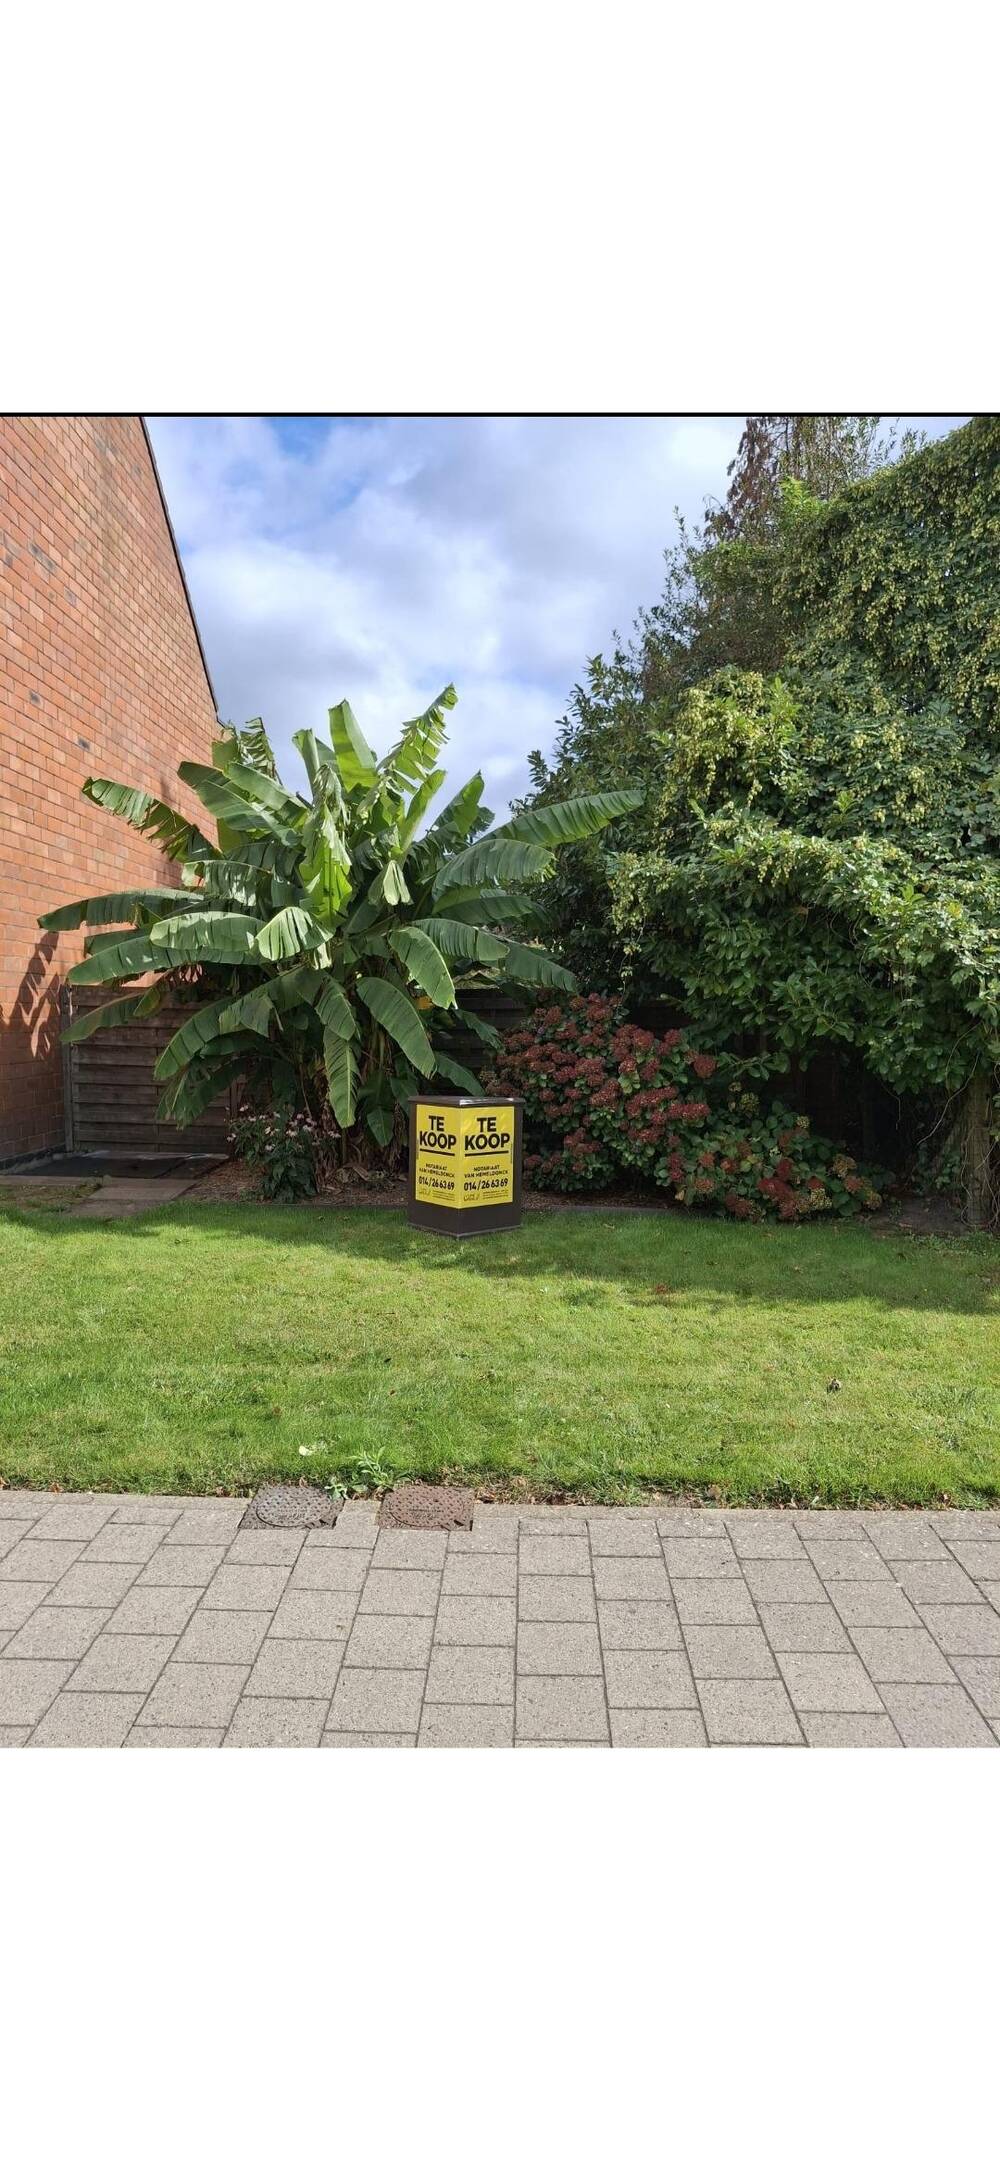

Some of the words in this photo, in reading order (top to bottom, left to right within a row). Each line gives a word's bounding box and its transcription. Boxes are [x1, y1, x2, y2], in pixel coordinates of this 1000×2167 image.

[428, 1115, 445, 1131] TE
[476, 1117, 497, 1133] TE
[419, 1131, 456, 1150] KOOP
[464, 1133, 510, 1150] KOOP
